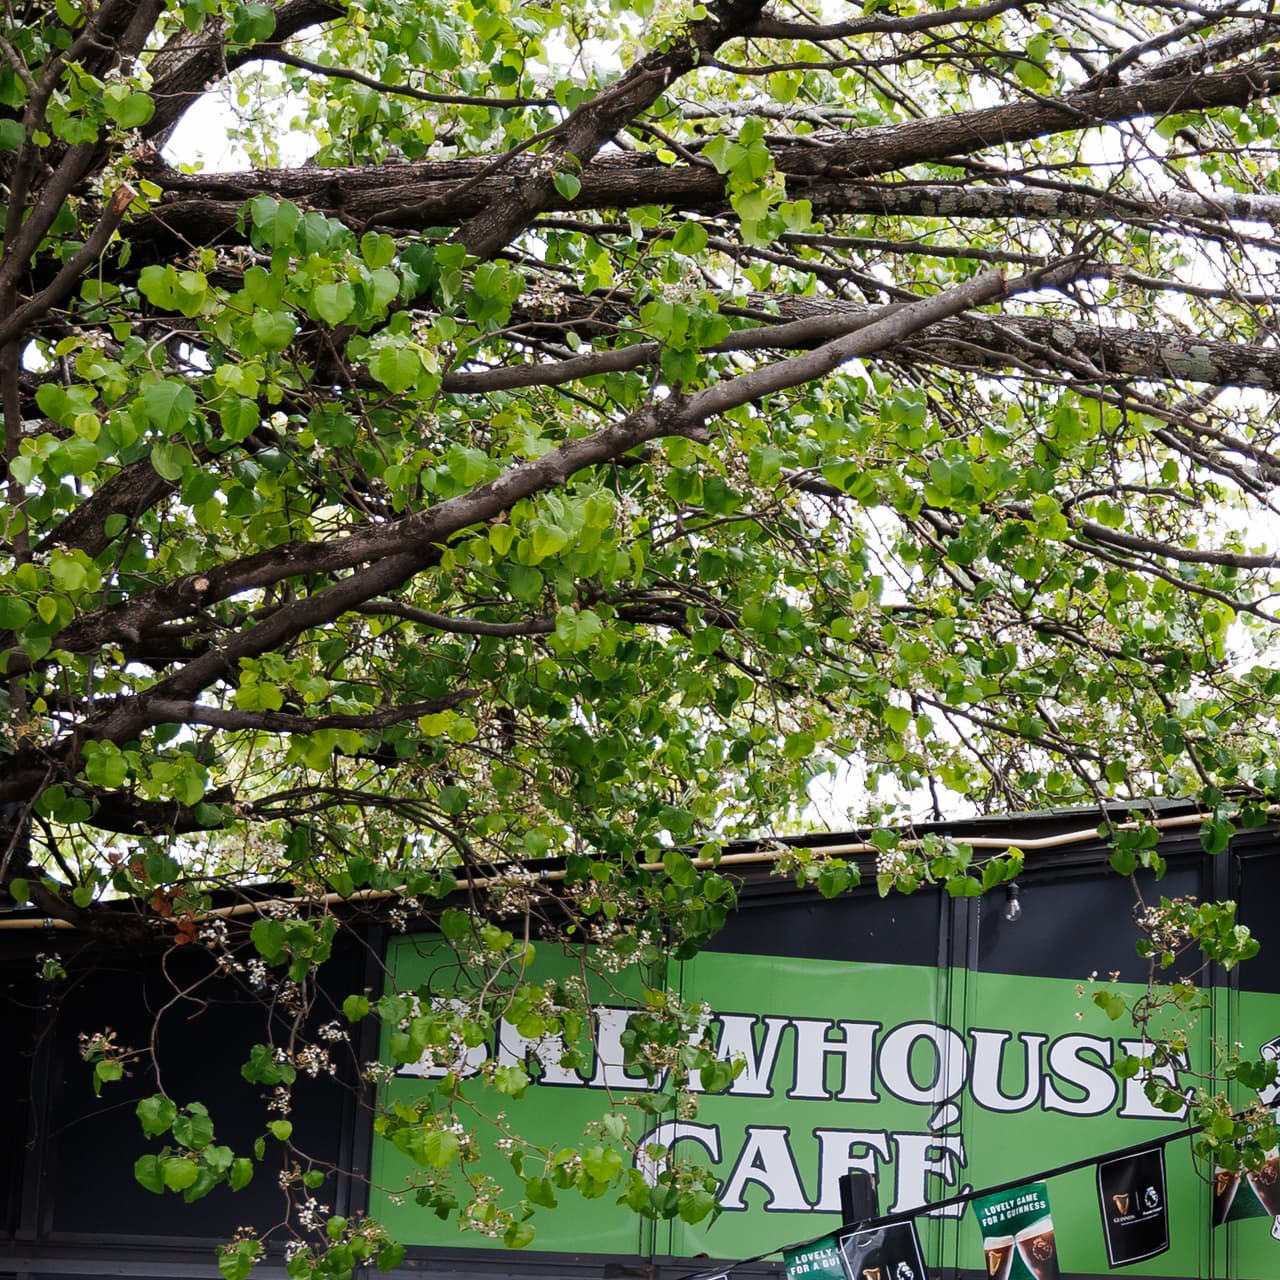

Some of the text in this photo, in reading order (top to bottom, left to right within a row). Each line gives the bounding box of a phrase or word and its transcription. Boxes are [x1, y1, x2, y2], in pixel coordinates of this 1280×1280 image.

[633, 1096, 974, 1220] CAFÉ
[982, 1216, 998, 1227] FOR
[1007, 1201, 1046, 1220] GUINNESS
[984, 1193, 1039, 1215] LOVELY GAME
[795, 1248, 833, 1264] LOVELY
[790, 1265, 810, 1276] FOR
[813, 1262, 820, 1271] A
